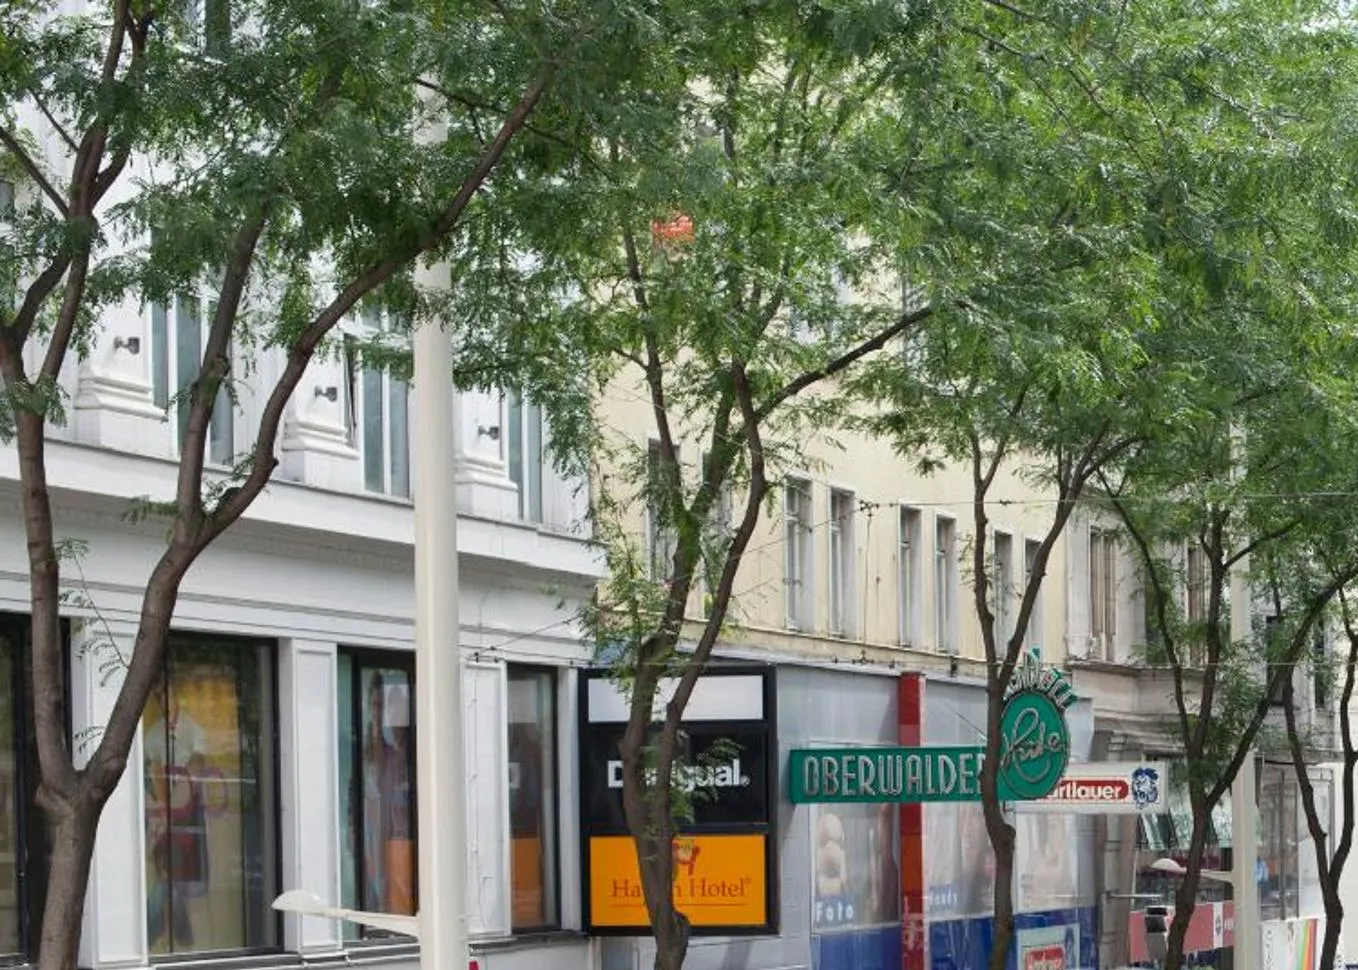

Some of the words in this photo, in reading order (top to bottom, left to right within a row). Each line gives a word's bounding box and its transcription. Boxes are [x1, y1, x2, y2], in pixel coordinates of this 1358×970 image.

[1047, 782, 1122, 800] artlauer
[609, 877, 683, 899] Han
[690, 877, 746, 898] Hotel
[815, 901, 855, 922] Foto
